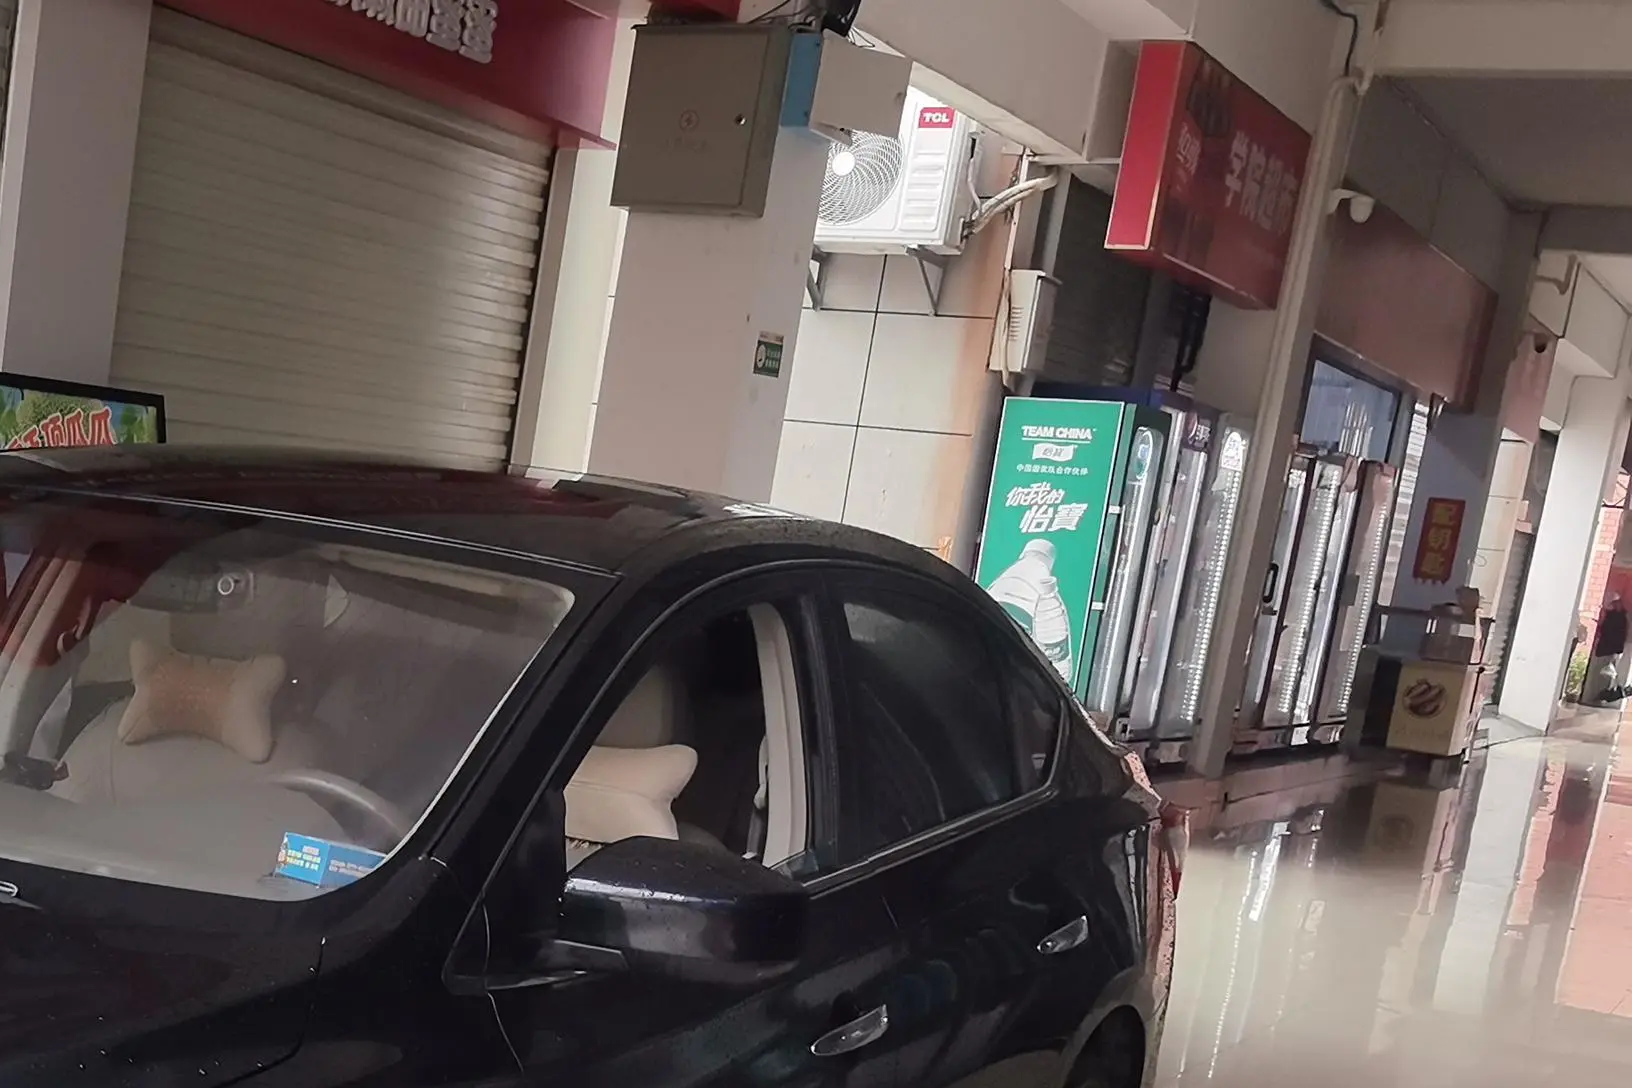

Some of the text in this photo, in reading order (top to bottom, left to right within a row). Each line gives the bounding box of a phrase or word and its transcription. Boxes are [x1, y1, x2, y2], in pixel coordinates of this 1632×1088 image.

[923, 111, 951, 123] TCL
[1021, 425, 1093, 440] TEAM CHINA
[1005, 481, 1066, 507] 你我的
